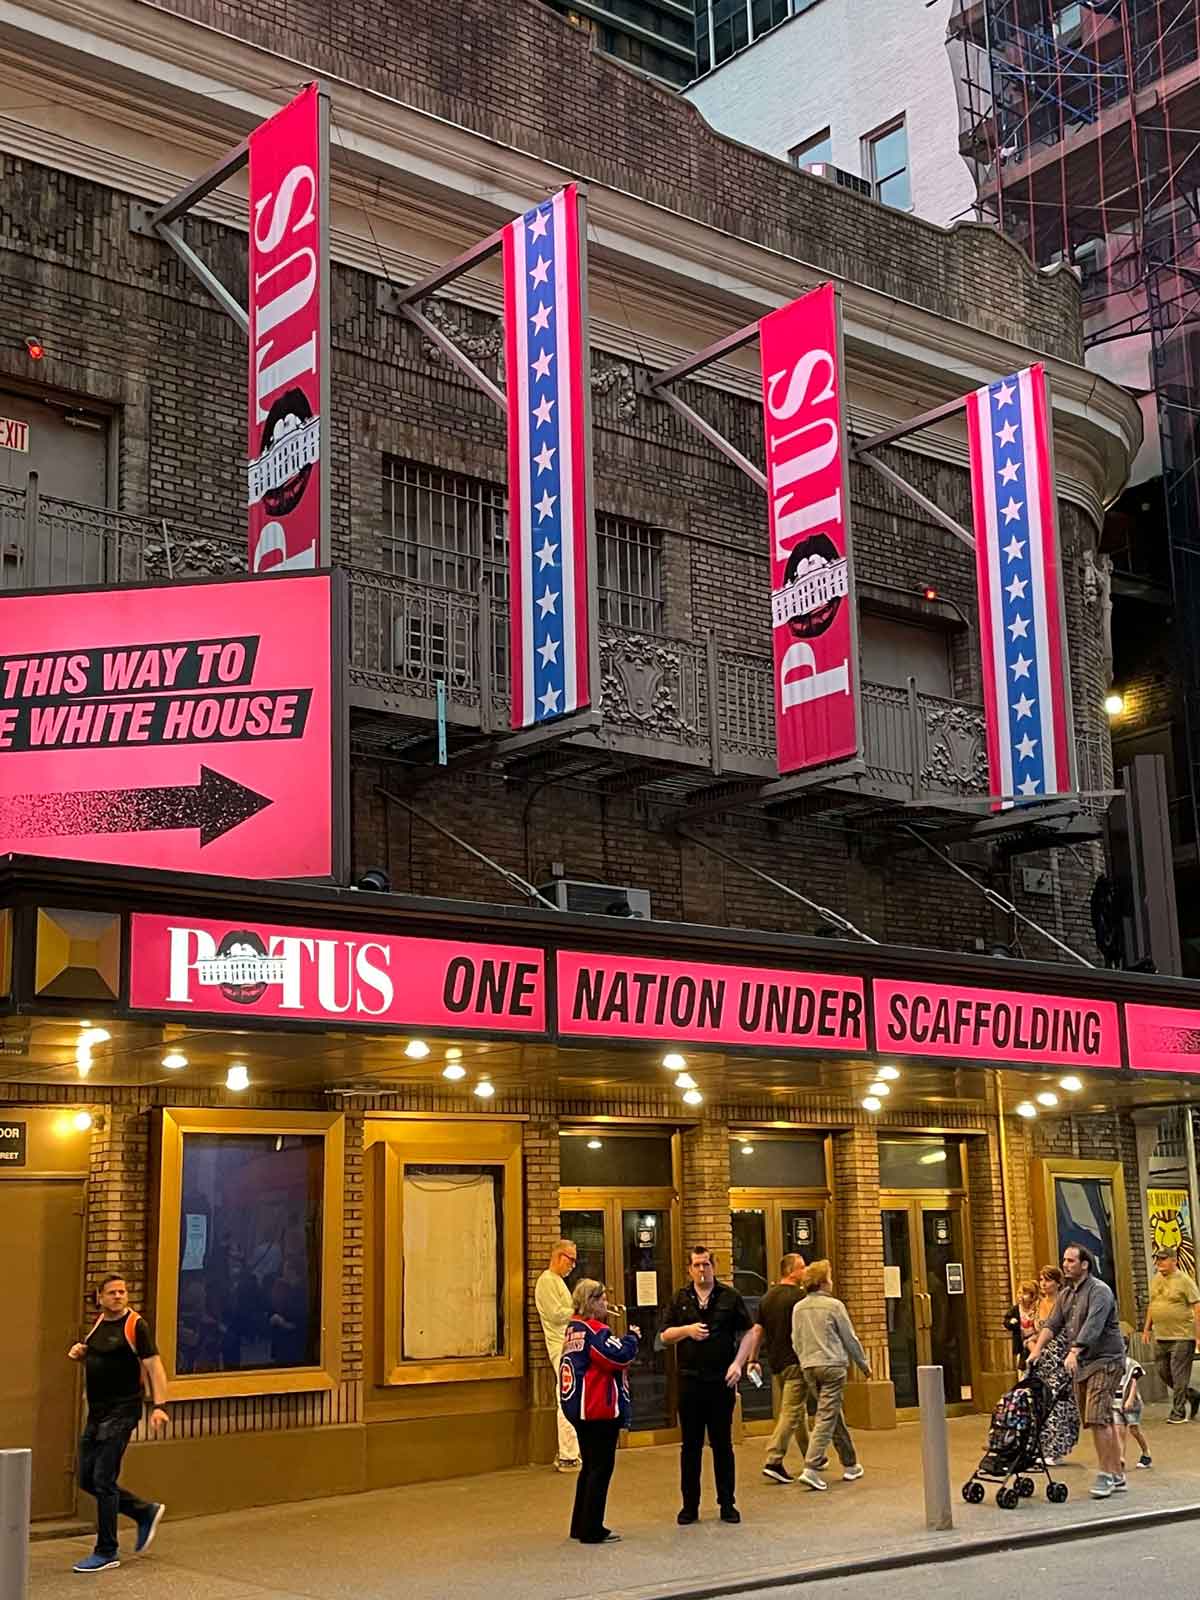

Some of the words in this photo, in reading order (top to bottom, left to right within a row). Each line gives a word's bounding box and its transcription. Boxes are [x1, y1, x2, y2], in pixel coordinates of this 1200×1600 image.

[767, 348, 849, 715] POTUS
[4, 655, 91, 699] THIS
[103, 648, 188, 691] WAY
[197, 642, 246, 684] TO
[30, 702, 155, 745] WHITE
[162, 695, 298, 740] HOUSE
[165, 927, 394, 1015] POTUS
[443, 957, 538, 1016] ONE
[572, 968, 726, 1029] NATION
[738, 982, 863, 1039] UNDER
[888, 994, 1101, 1055] SCAFFOLDING
